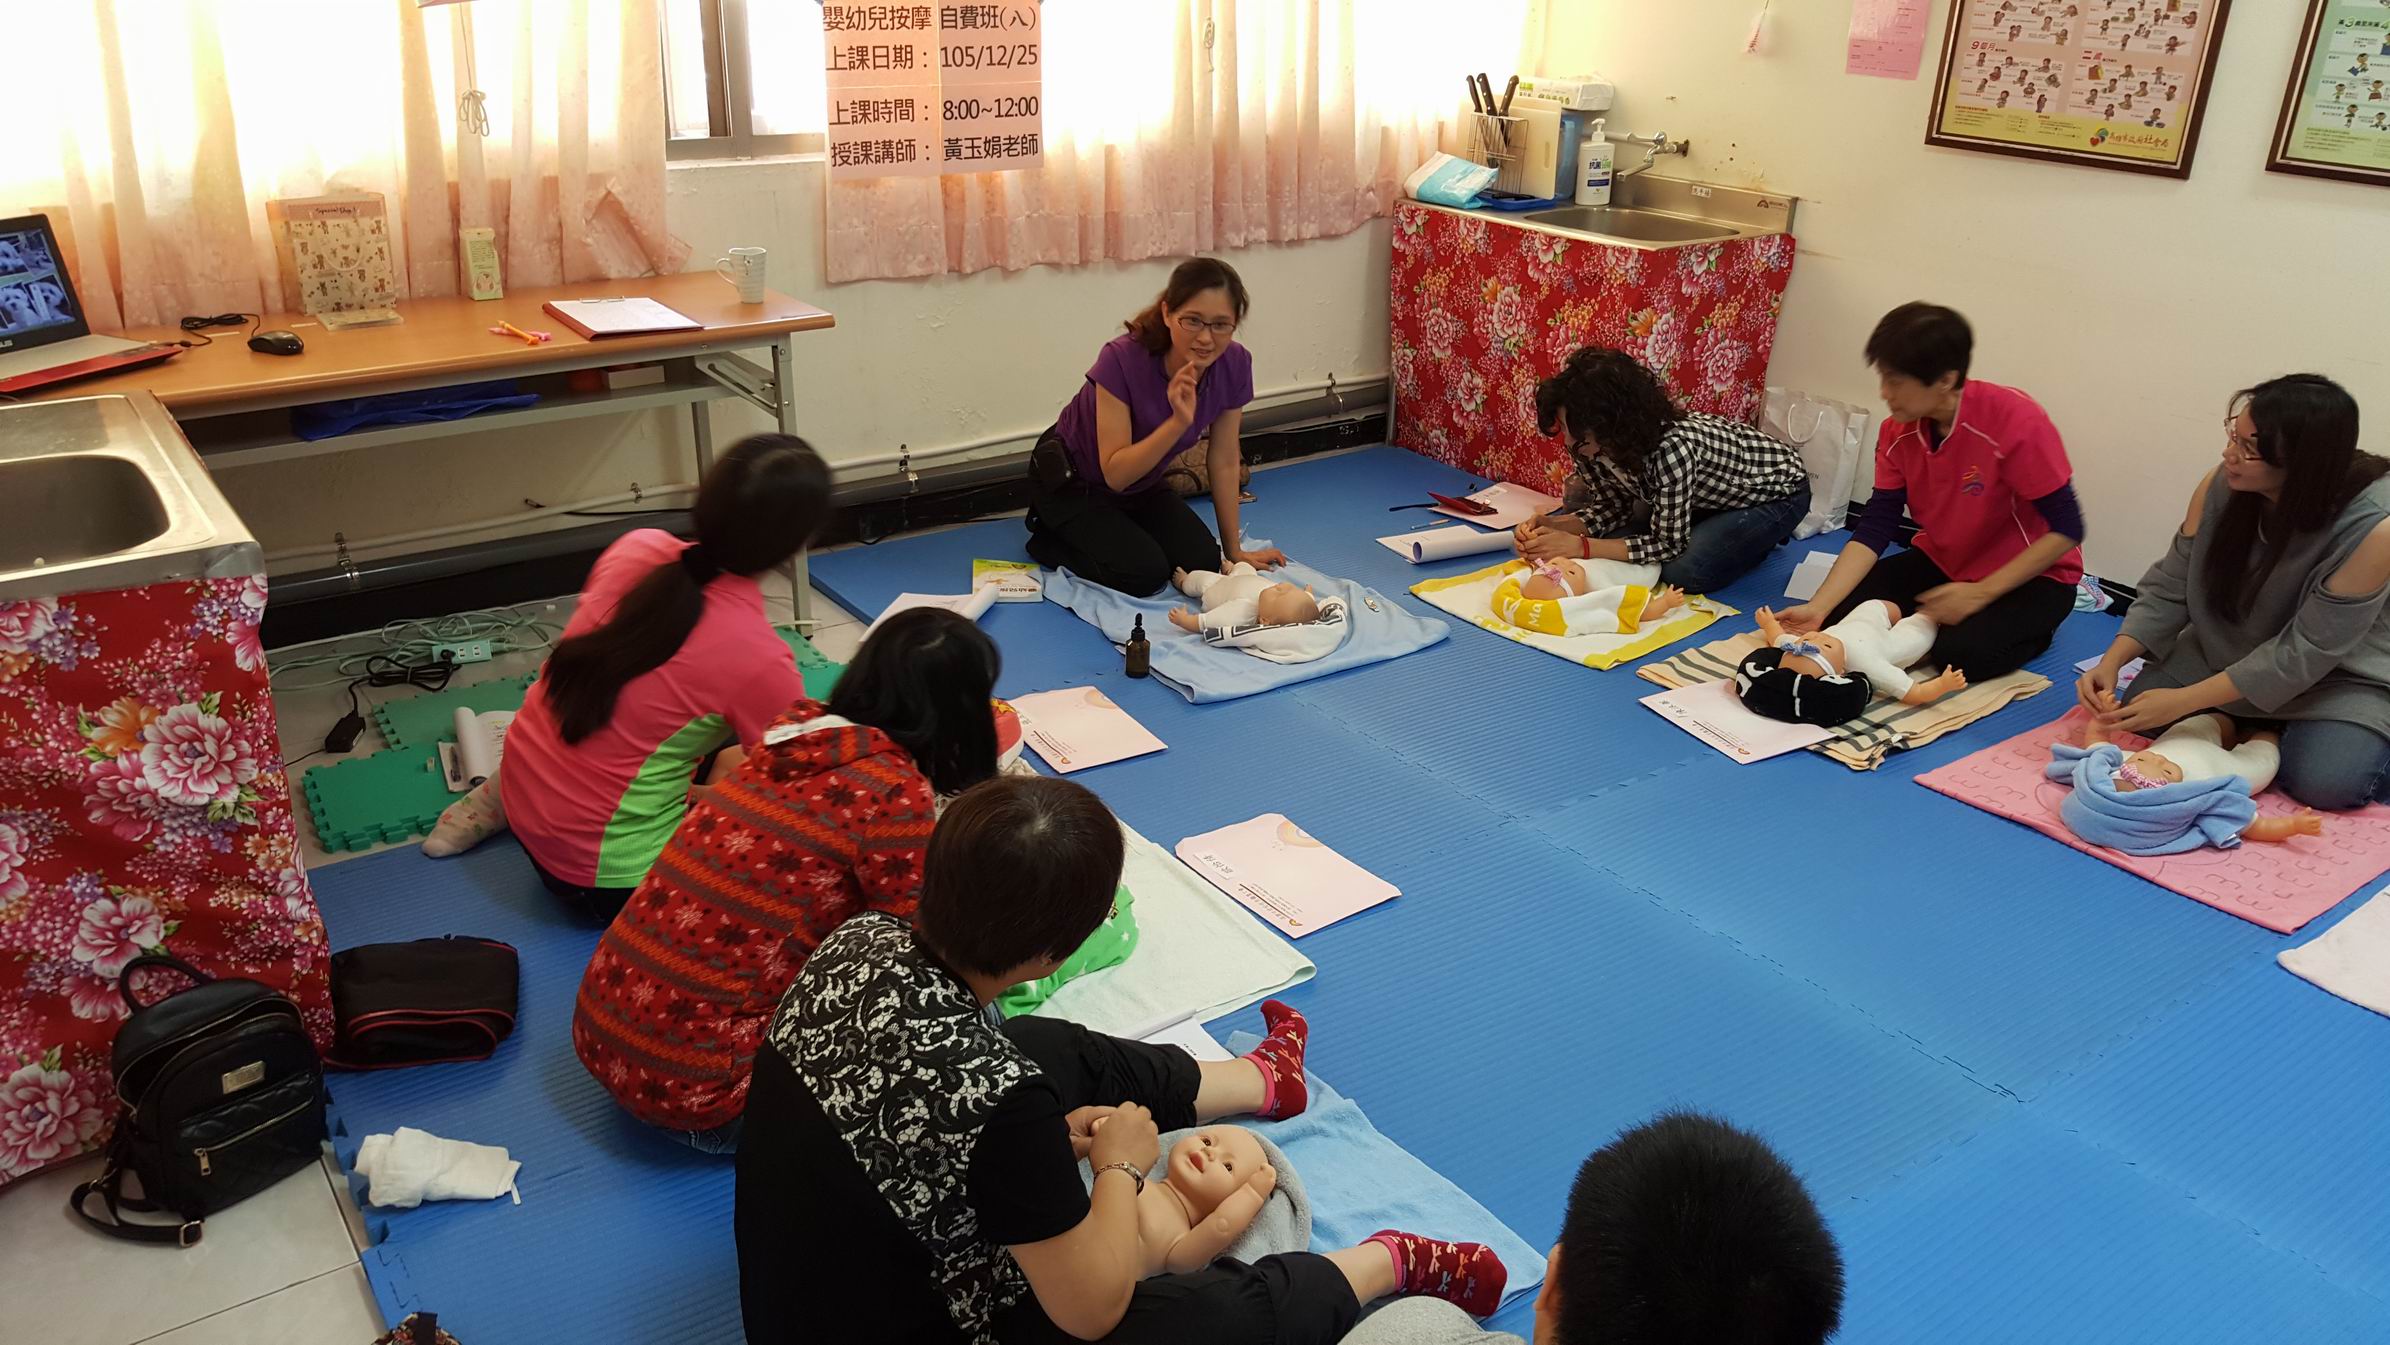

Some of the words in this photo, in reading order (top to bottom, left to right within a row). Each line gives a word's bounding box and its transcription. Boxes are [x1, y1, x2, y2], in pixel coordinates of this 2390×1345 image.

[823, 5, 932, 32] 嬰幼兒按摩
[940, 44, 1038, 70] 105/12/25
[942, 96, 1039, 122] 8:00~12:00
[943, 133, 1039, 162] 黃玉娟老師
